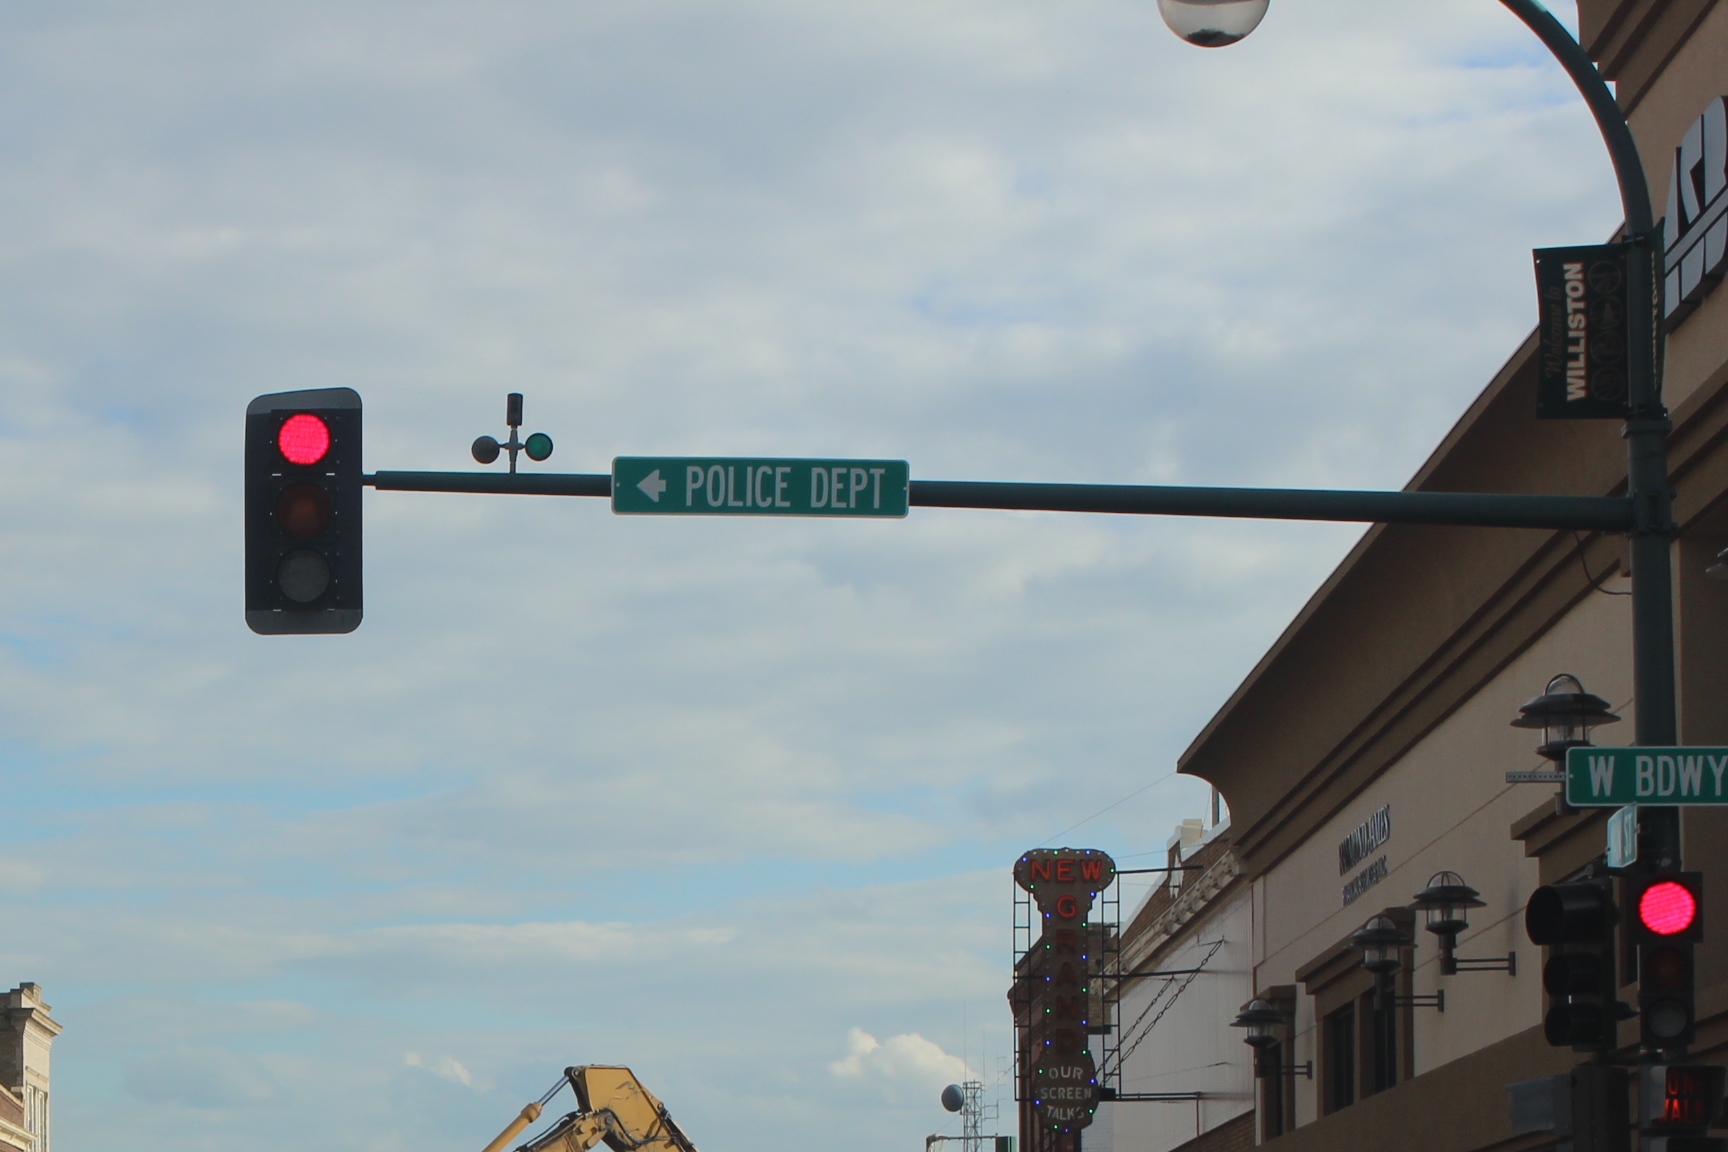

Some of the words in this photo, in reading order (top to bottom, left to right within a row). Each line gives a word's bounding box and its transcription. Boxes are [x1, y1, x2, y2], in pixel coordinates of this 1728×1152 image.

[1563, 262, 1587, 401] WILLISTON
[686, 465, 791, 507] POLICE
[811, 467, 885, 509] DEPT
[1588, 756, 1615, 797] W
[1635, 755, 1728, 797] BDWY
[1030, 859, 1103, 881] NEW
[1048, 1065, 1084, 1080] OUR
[1040, 1087, 1092, 1100] SCREEN
[1047, 1104, 1085, 1121] TALKS
